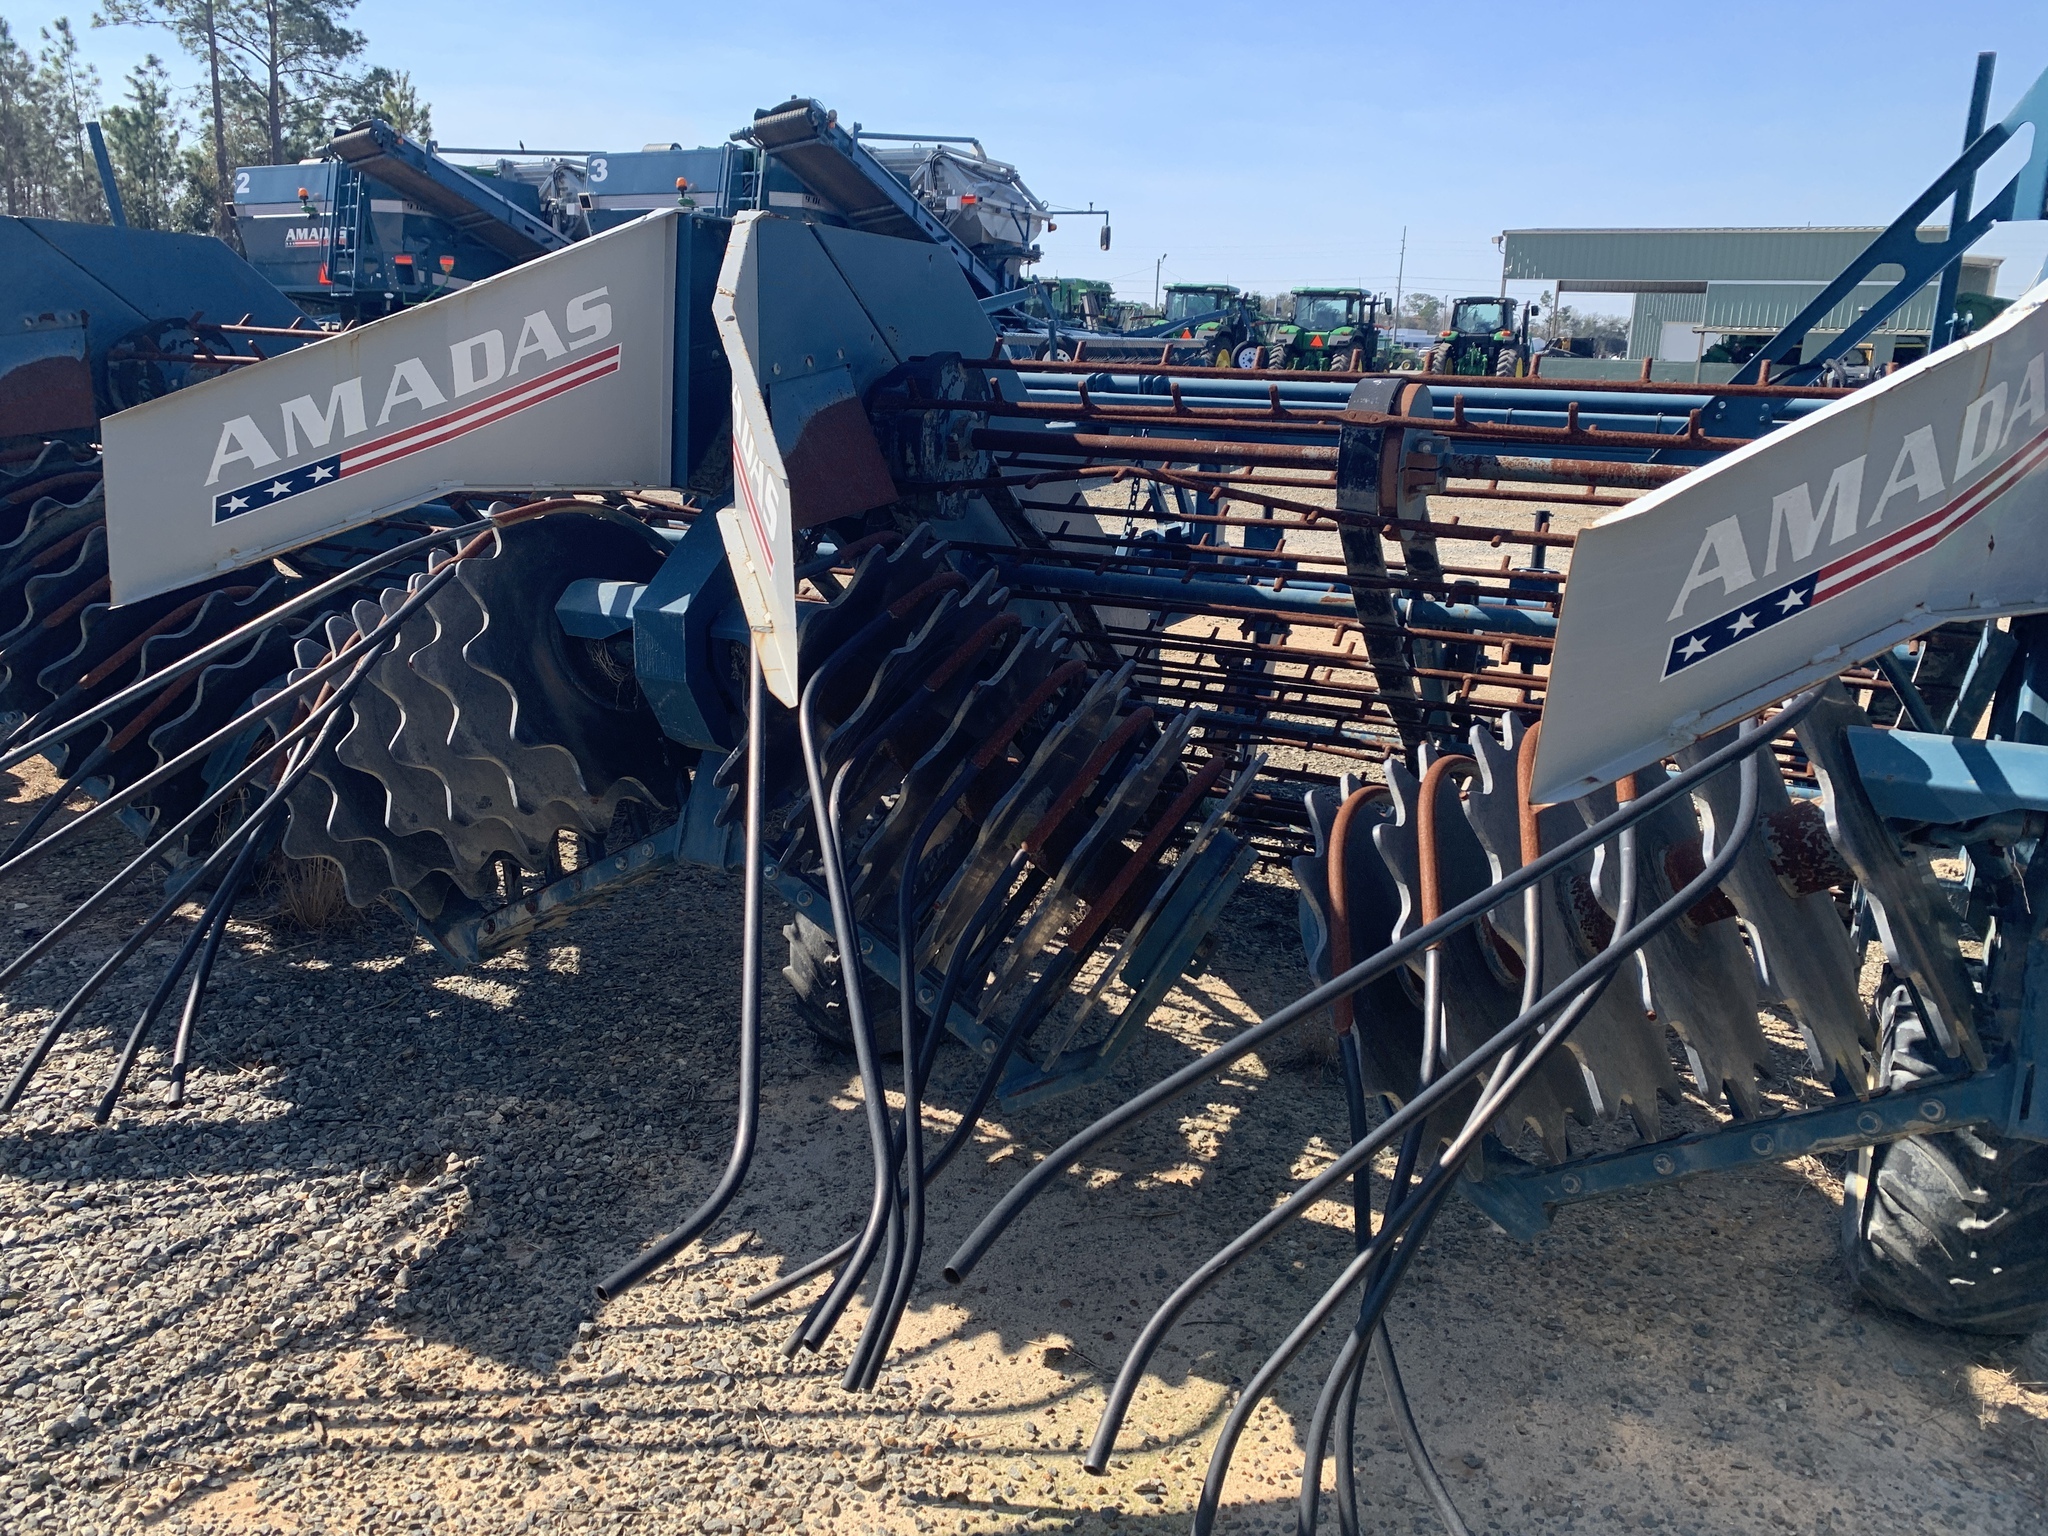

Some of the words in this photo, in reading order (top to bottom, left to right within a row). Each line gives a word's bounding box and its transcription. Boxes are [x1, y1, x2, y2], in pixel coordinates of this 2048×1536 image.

[590, 158, 608, 182] 3
[236, 172, 250, 194] 2
[285, 226, 347, 241] AMADS
[204, 286, 612, 487] AMADAS
[1666, 352, 2045, 624] AMADA
